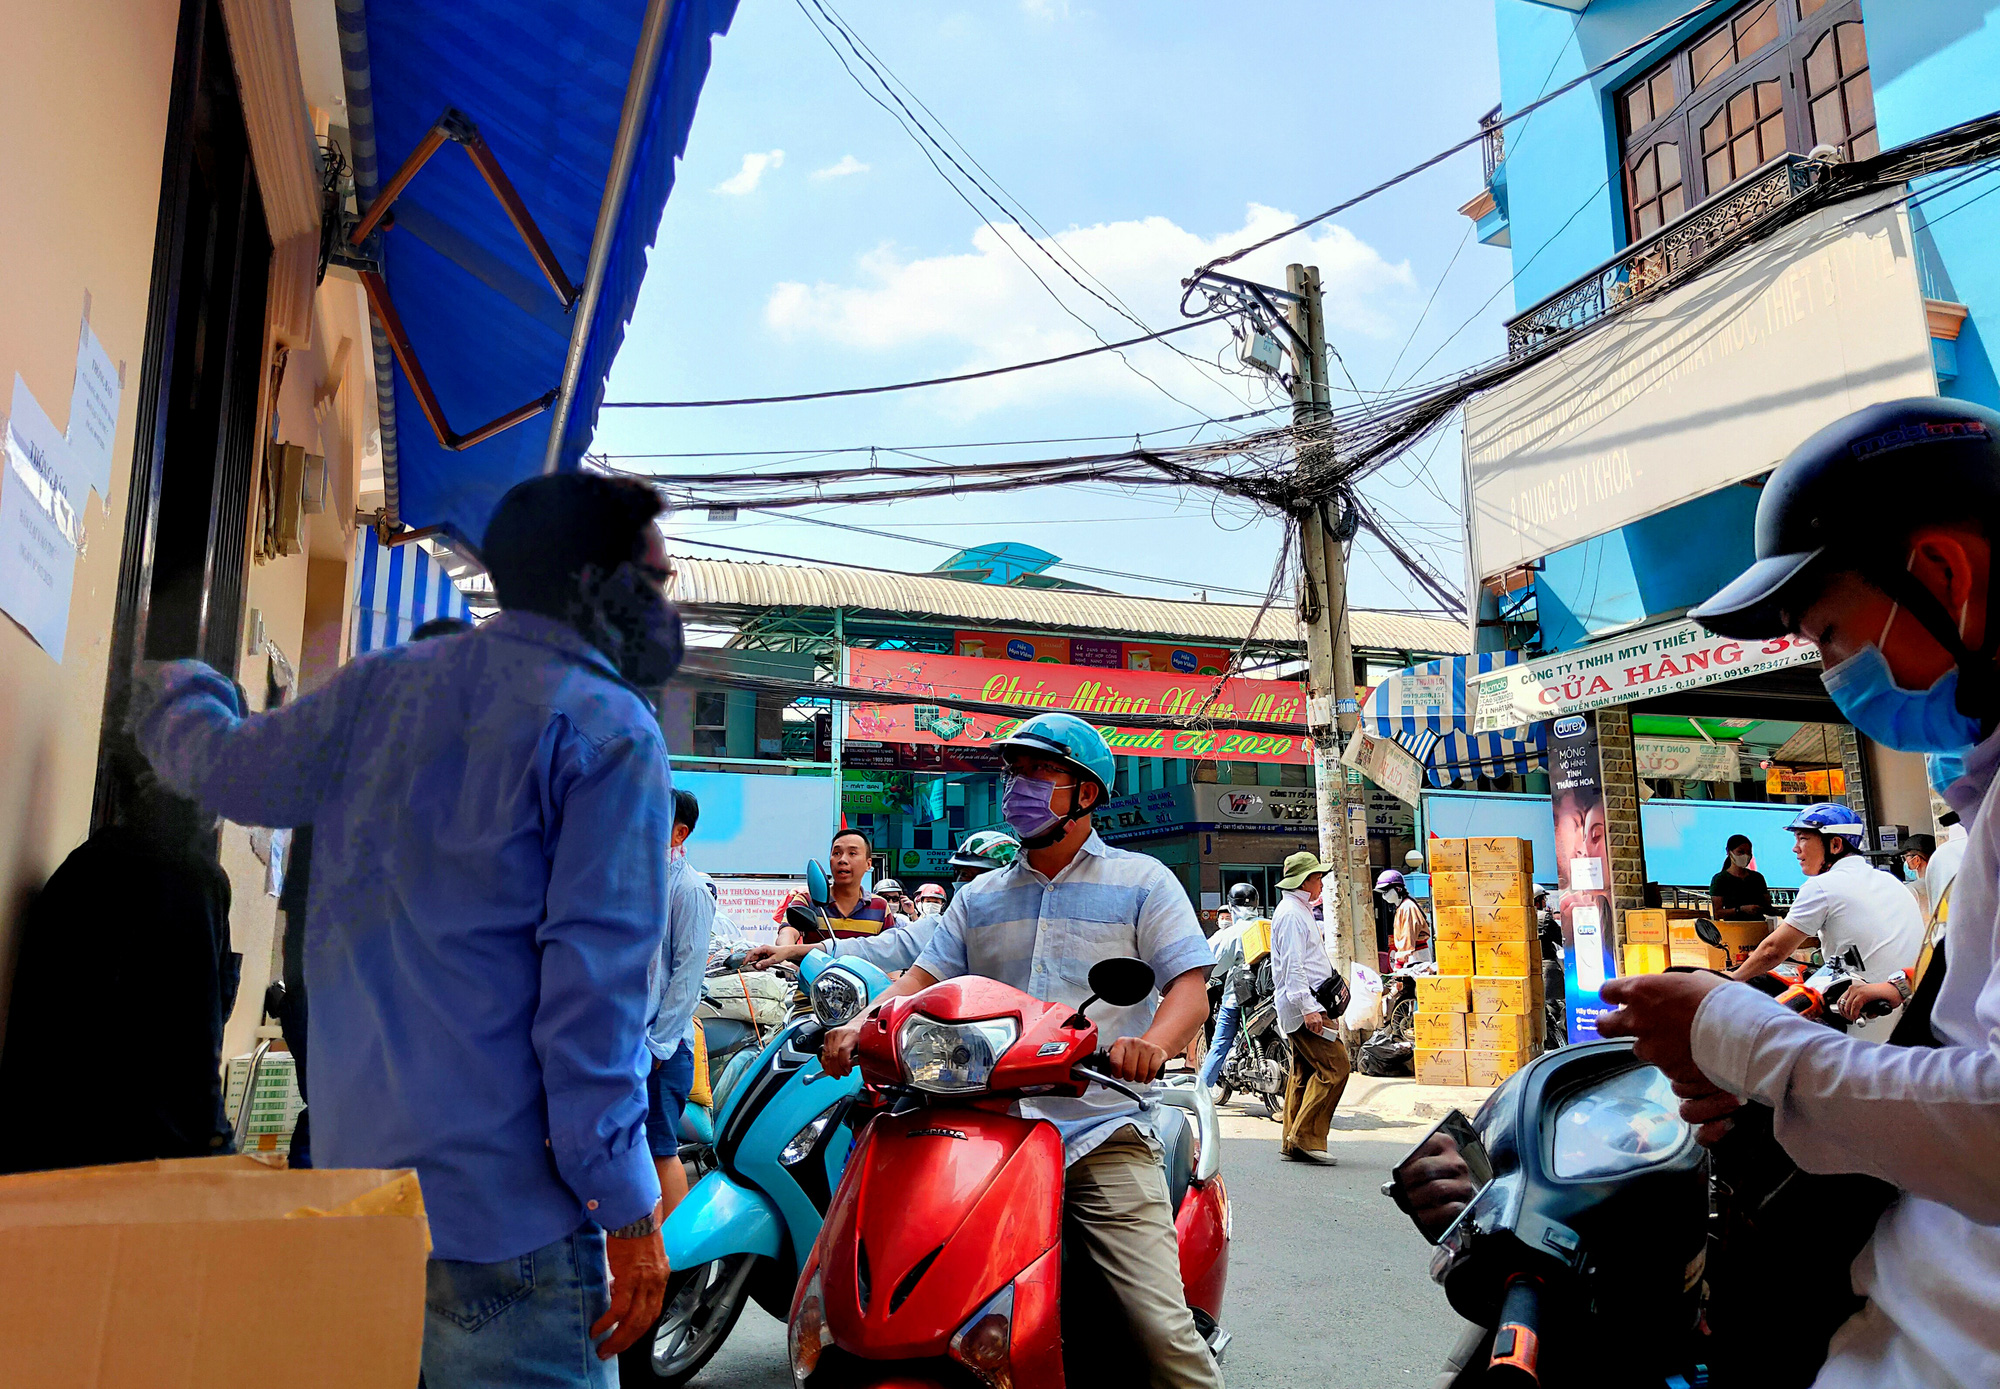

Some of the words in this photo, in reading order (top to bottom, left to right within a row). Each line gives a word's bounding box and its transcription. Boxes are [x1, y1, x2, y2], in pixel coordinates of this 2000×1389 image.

[1521, 479, 1557, 535] DỤNG
[1559, 466, 1578, 520] CỤ
[1579, 464, 1589, 506] Y
[1592, 447, 1634, 502] KHOA
[1521, 667, 1554, 685] CÔNG
[1556, 663, 1574, 676] TY
[1577, 652, 1614, 671] TNHH
[1618, 643, 1648, 661] MTV
[1653, 628, 1698, 652] THIẾT
[1538, 674, 1613, 706] CỬA
[1623, 641, 1744, 688] HÀNG
[1557, 700, 1591, 716] NGUYỄN
[1612, 691, 1640, 704] THANH
[1648, 684, 1668, 695] P.15
[1675, 678, 1696, 690] Q.10
[1705, 672, 1722, 683] ĐT:
[1724, 656, 1791, 679] 0918.283477
[981, 674, 1057, 708] Chúc
[1061, 680, 1151, 714] Mừng
[1247, 693, 1299, 722] Mới
[1557, 720, 1583, 734] durex
[1173, 730, 1218, 756] Tý
[1221, 734, 1292, 756] 2020
[1559, 746, 1586, 760] MỎNG
[1580, 778, 1595, 787] HOA
[1375, 812, 1387, 824] SỐ
[1388, 816, 1394, 824] 1
[730, 887, 760, 896] THƯƠNG
[760, 889, 776, 897] MẠI
[744, 897, 766, 906] THIẾT
[767, 899, 775, 907] BỊ
